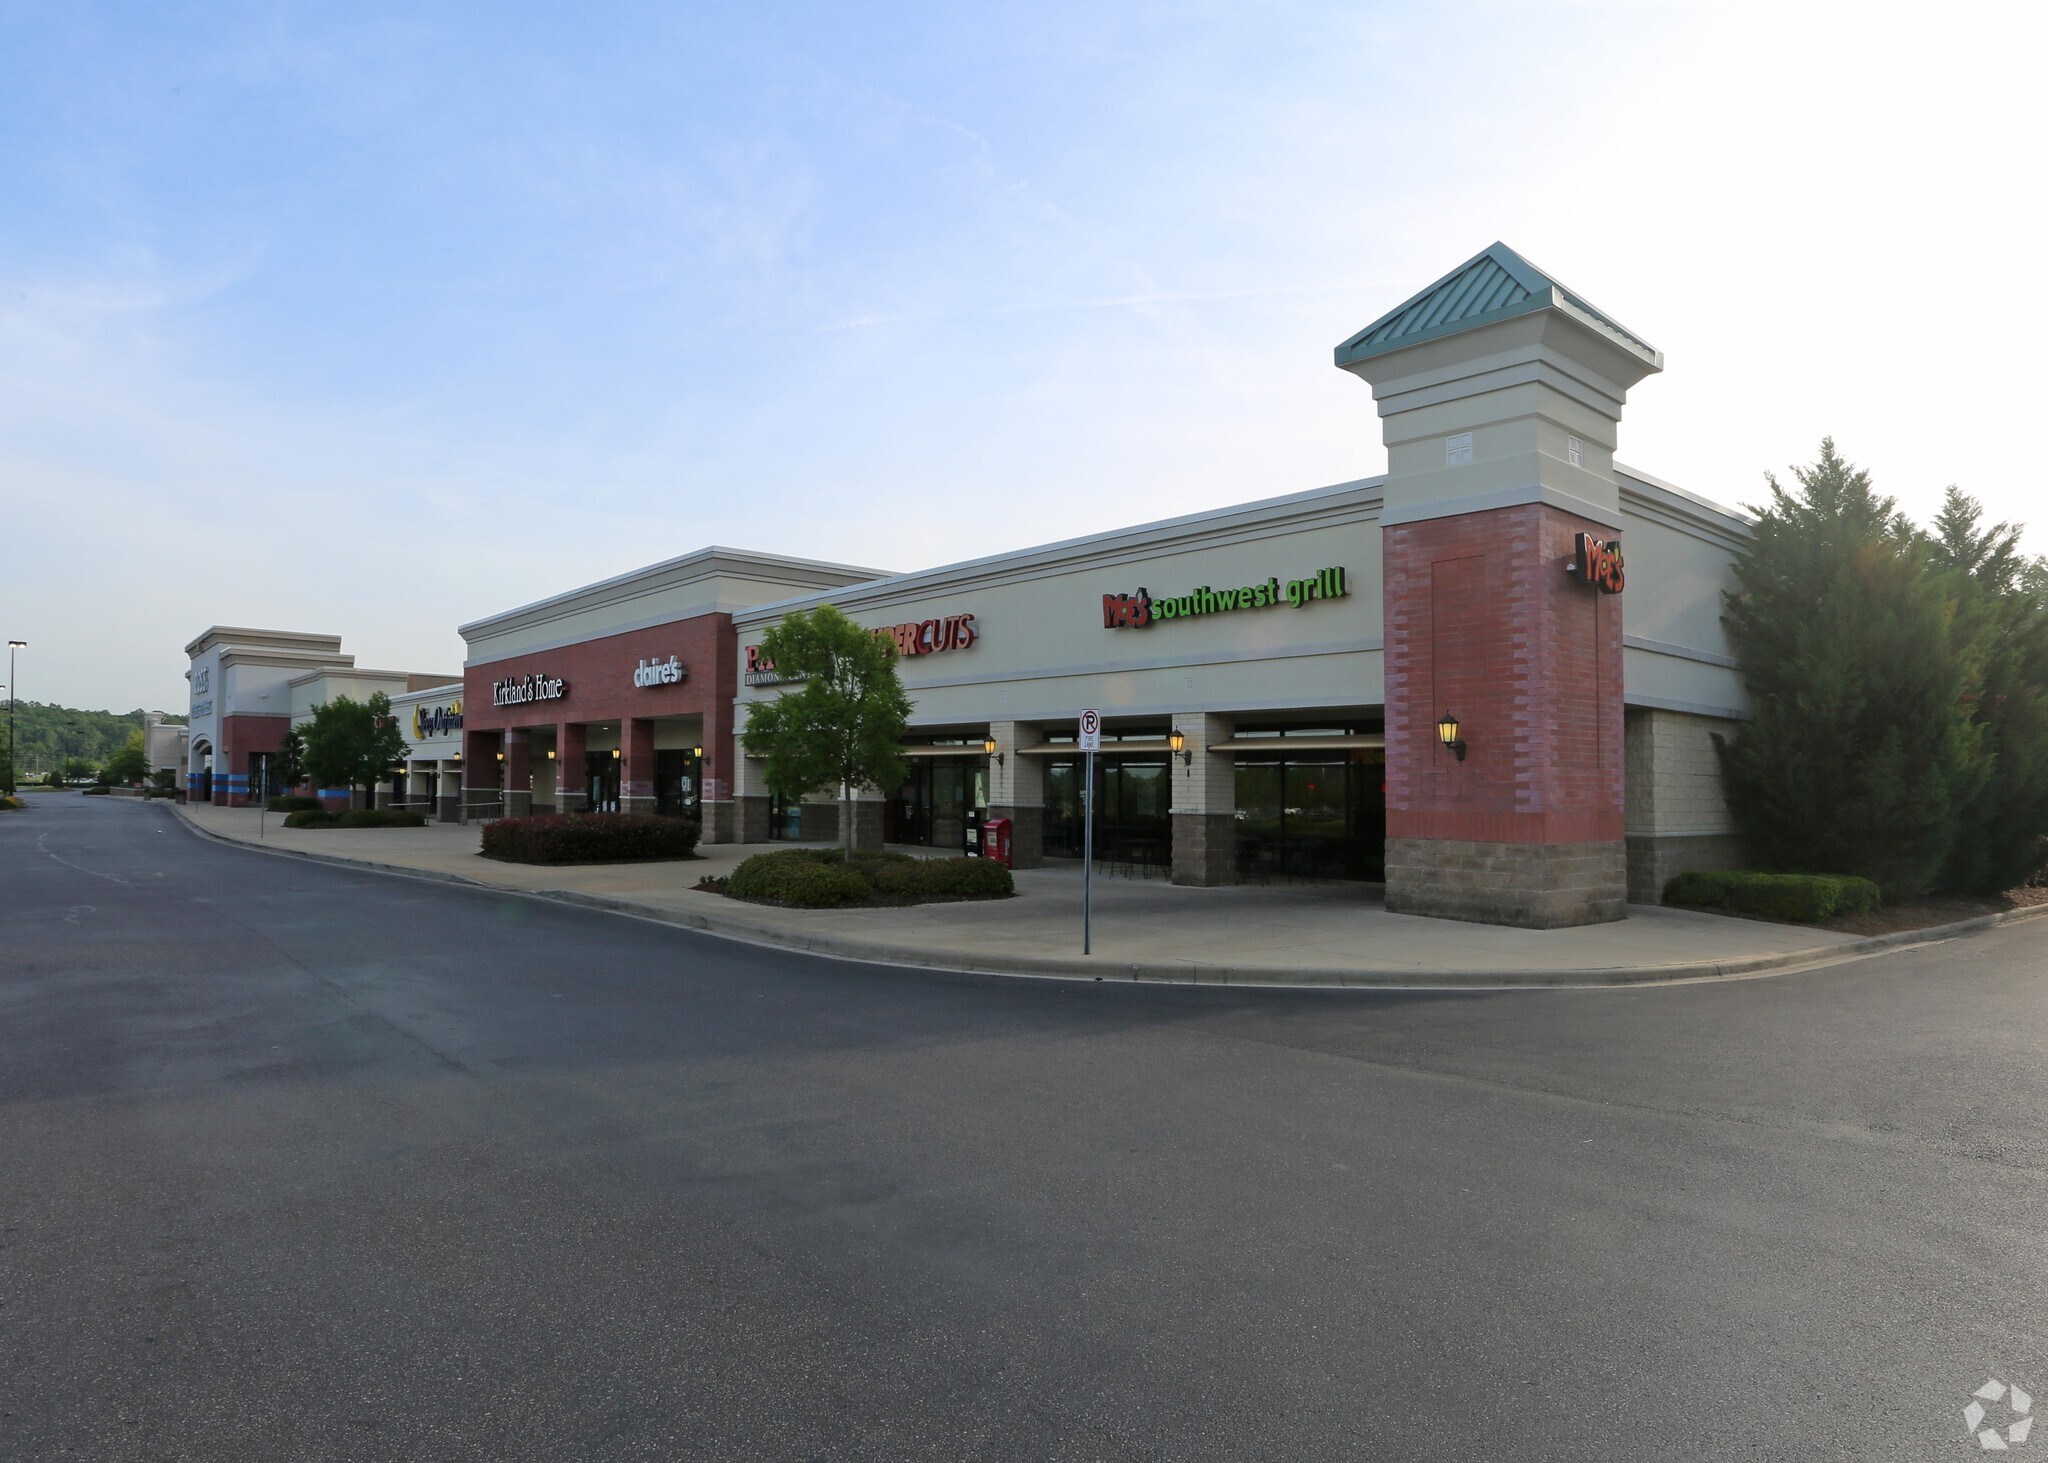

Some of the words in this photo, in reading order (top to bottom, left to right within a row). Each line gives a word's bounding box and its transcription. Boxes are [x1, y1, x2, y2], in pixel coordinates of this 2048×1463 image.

[1151, 577, 1279, 620] southwest
[1286, 566, 1346, 608] grill
[633, 655, 681, 687] claire's
[493, 675, 533, 706] Kirkland's
[535, 674, 563, 700] Home
